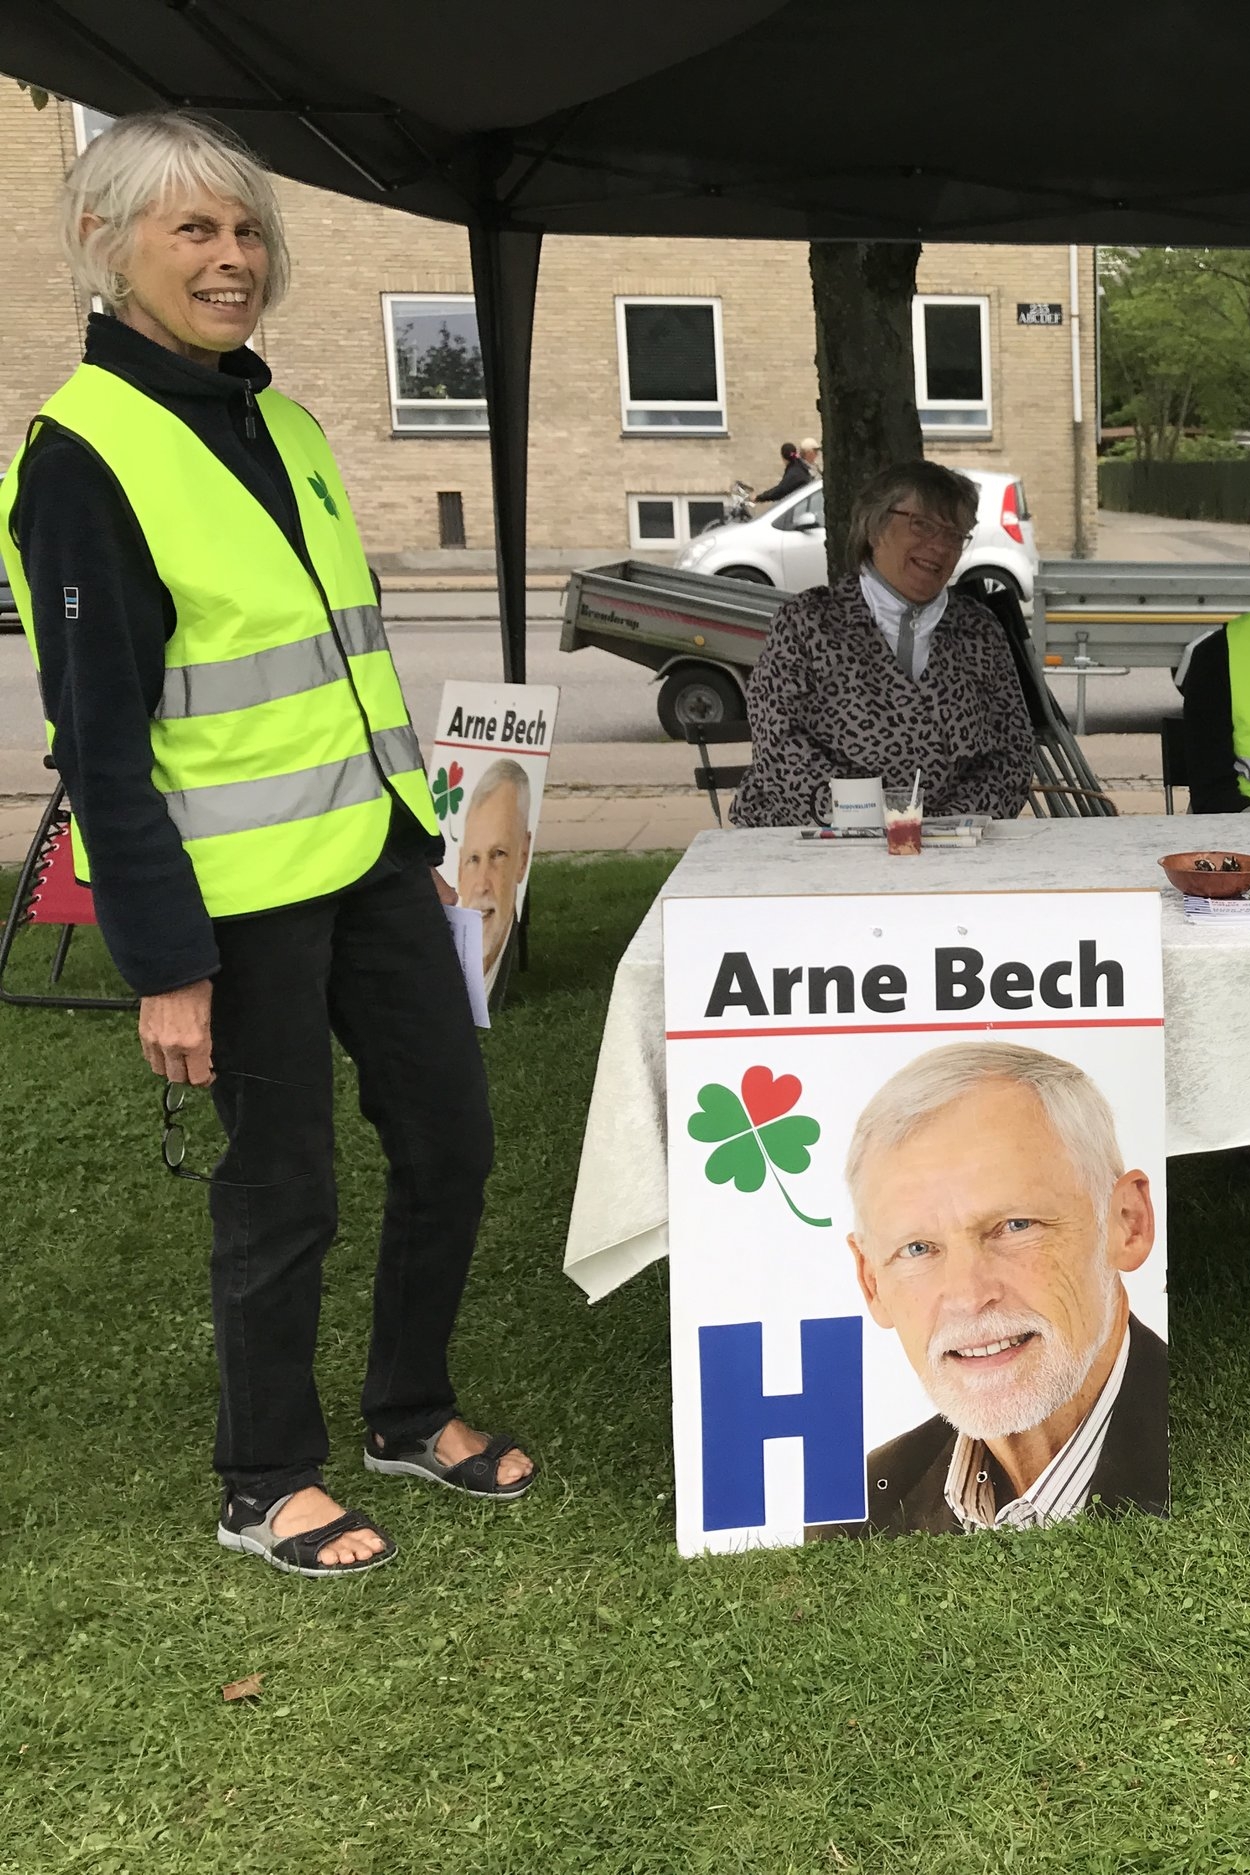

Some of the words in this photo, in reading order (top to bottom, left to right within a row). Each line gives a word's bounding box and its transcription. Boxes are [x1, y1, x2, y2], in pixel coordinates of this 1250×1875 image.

[1018, 311, 1061, 324] ABCDEF
[581, 603, 640, 631] Brenderup
[446, 706, 497, 741] Arne
[501, 709, 548, 745] Bech
[704, 951, 908, 1018] Arne
[935, 940, 1125, 1011] Bech
[698, 1315, 867, 1532] H
